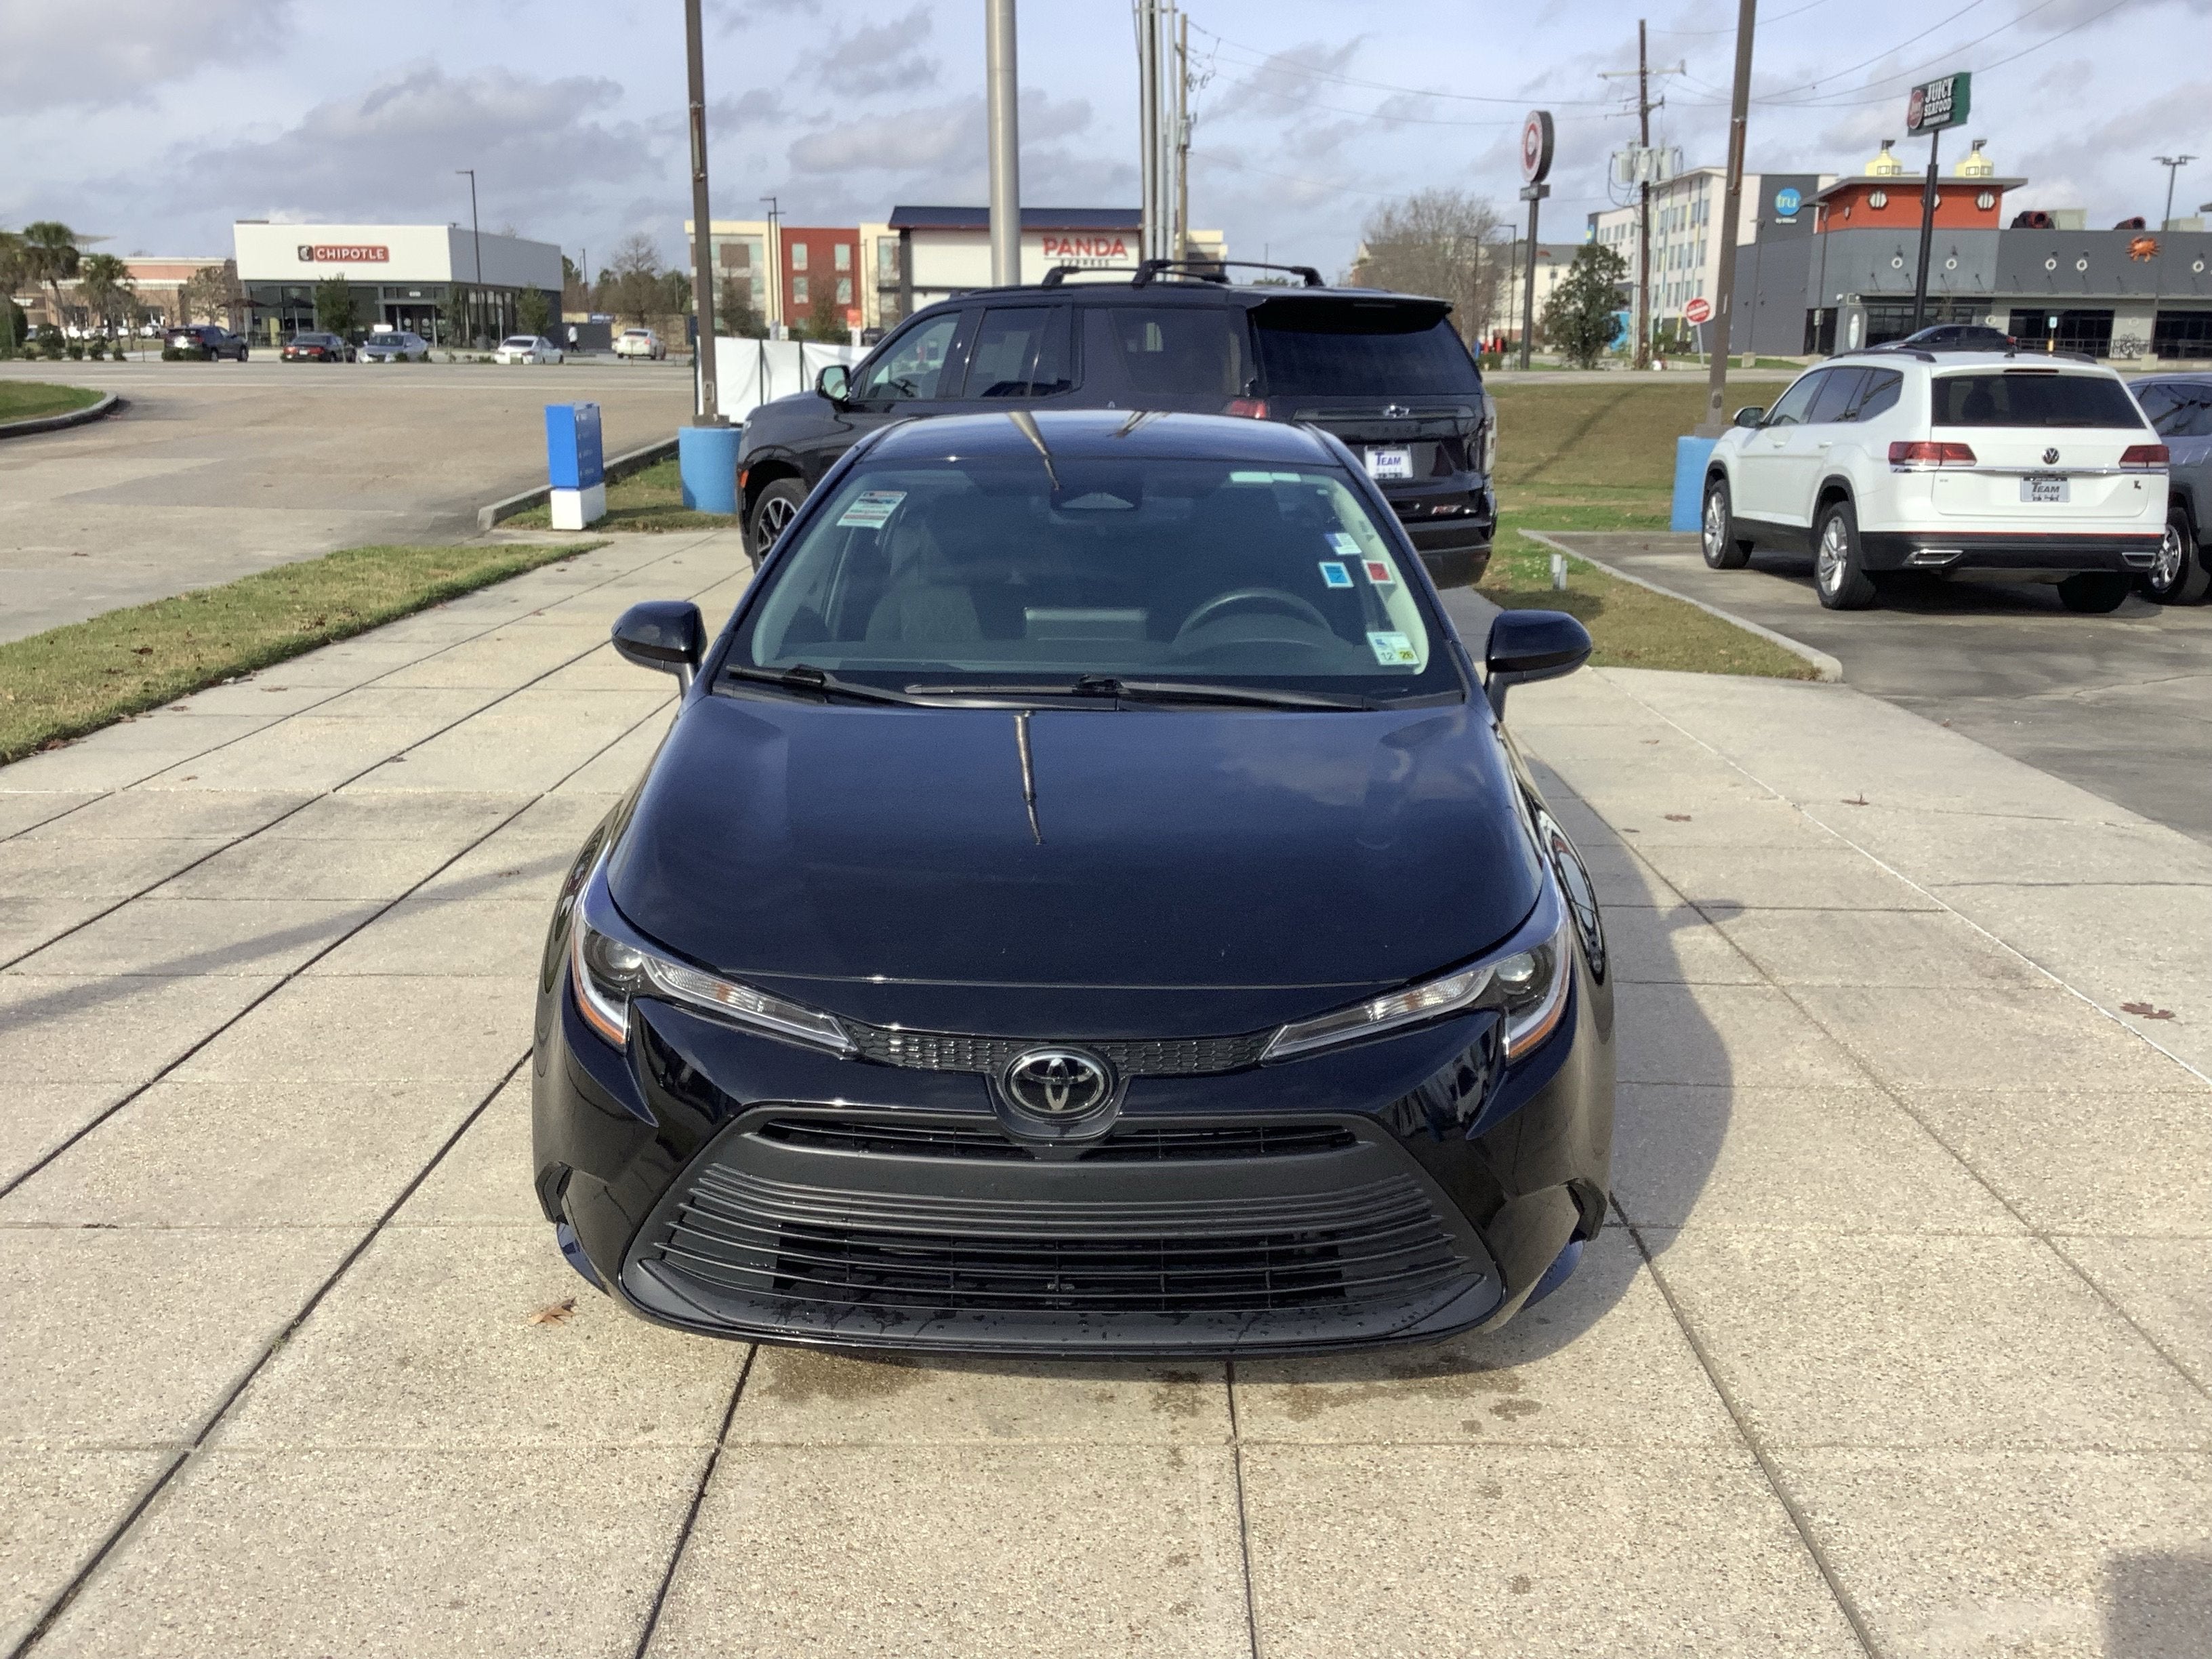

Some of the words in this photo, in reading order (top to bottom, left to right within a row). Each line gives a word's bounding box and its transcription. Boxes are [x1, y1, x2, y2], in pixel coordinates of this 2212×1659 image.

[1925, 77, 1954, 103] JUICY
[1924, 97, 1952, 117] SEAFOOD
[316, 248, 385, 260] CHIPOTLE
[1042, 237, 1127, 257] PANDA
